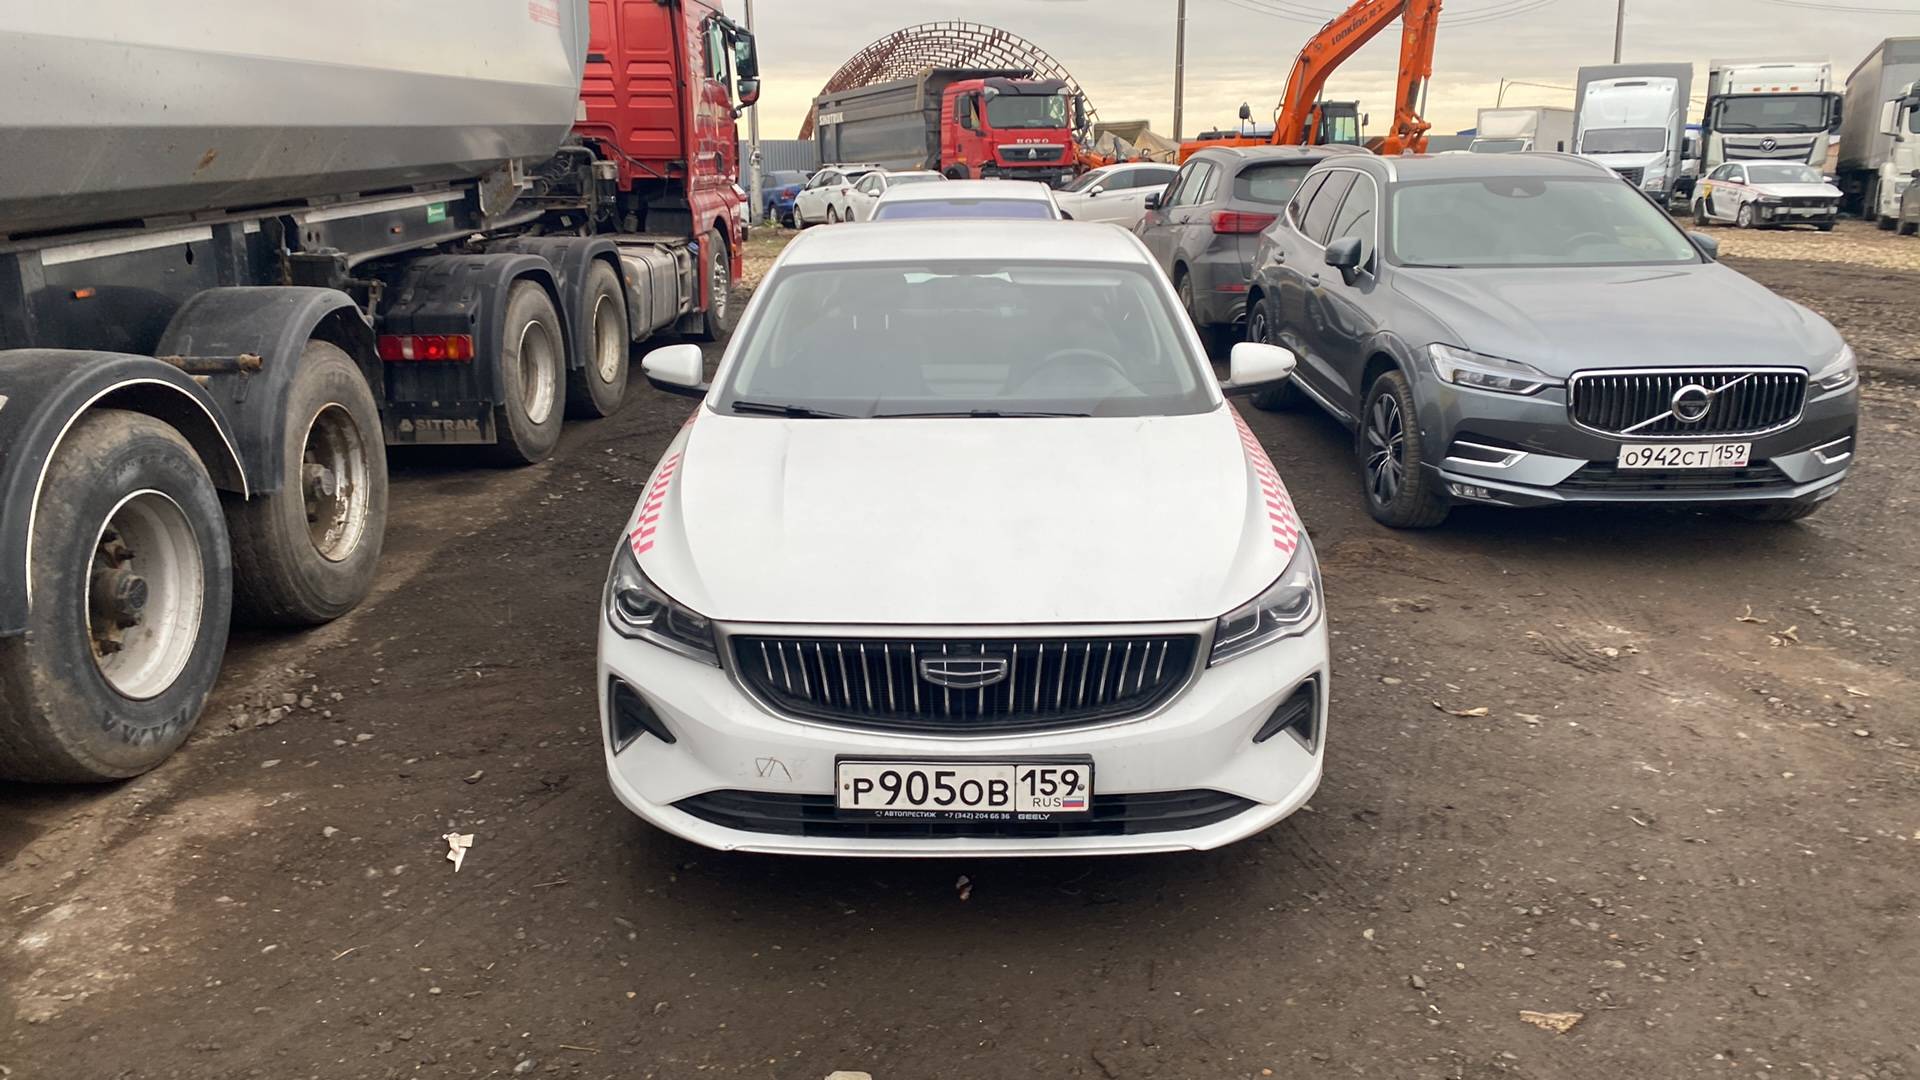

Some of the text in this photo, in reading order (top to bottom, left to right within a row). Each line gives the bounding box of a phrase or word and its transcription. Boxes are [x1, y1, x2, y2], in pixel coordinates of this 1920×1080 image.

[415, 418, 480, 433] SITRAK
[1715, 444, 1746, 460] 159
[853, 769, 1080, 806] Р905ОВ 159
[1032, 797, 1062, 808] RUS
[883, 810, 937, 818] АВТОПРЕСТИЖ
